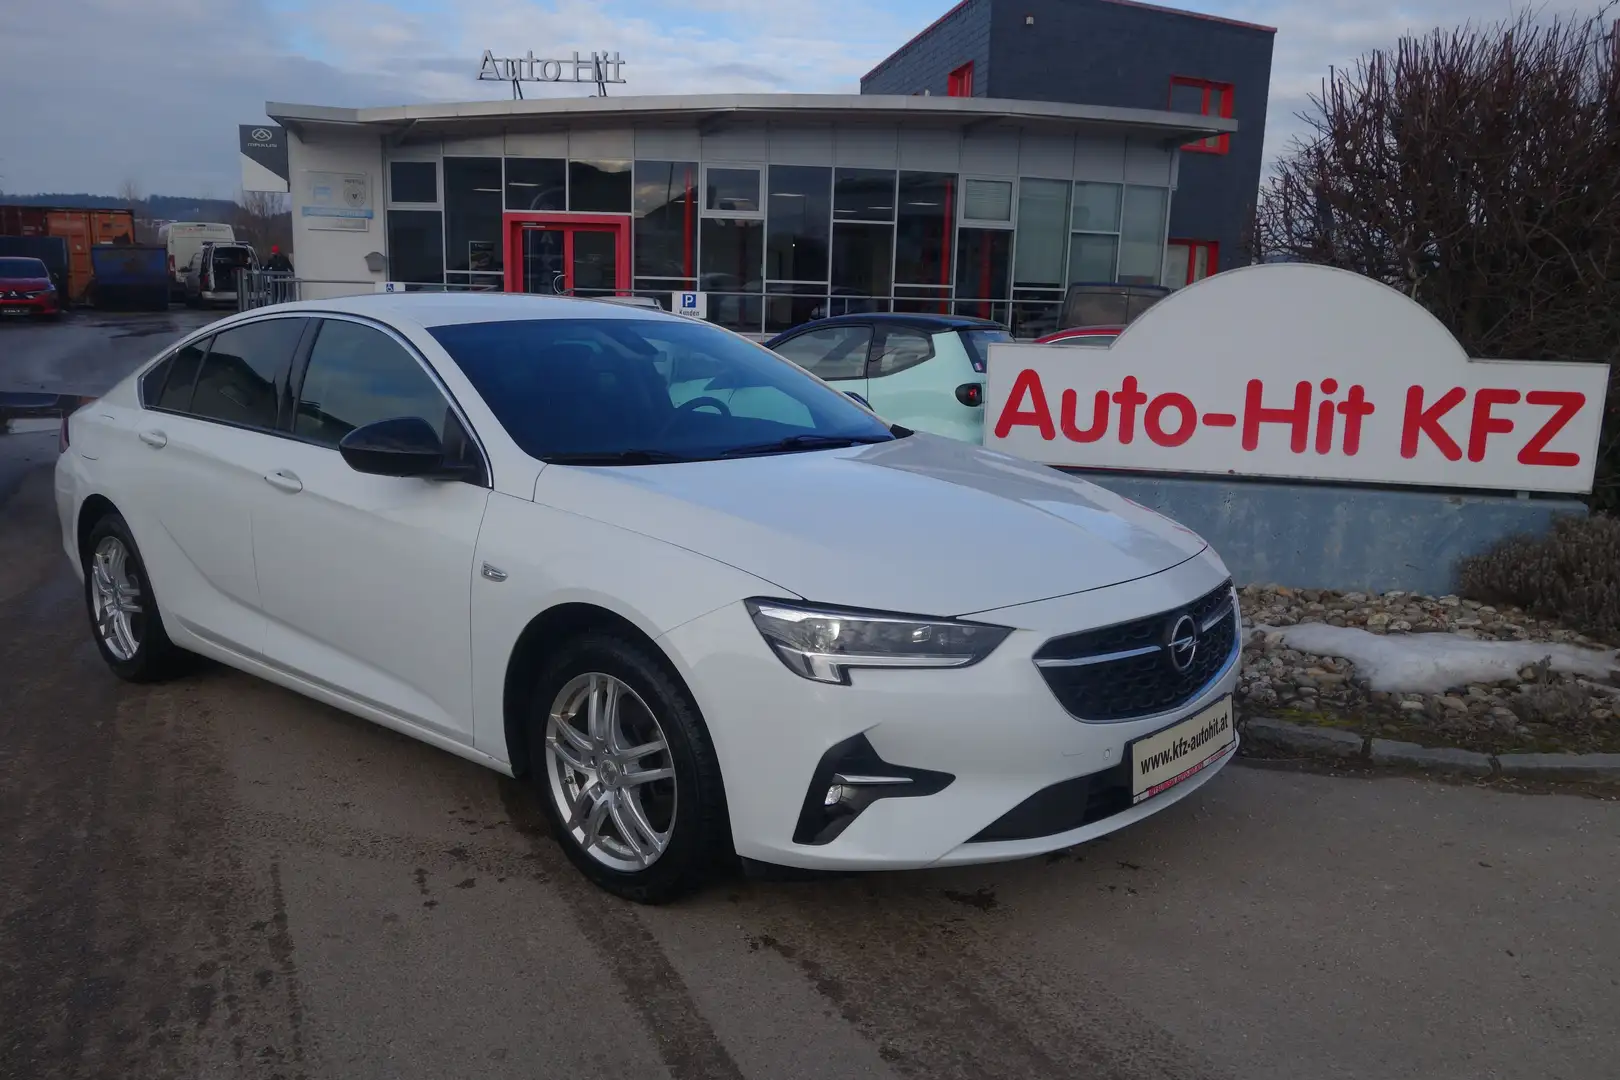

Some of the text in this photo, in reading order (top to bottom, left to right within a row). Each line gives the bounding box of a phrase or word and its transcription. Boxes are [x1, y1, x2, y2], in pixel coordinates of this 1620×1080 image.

[477, 49, 626, 83] Auto Hit
[679, 309, 700, 317] Kunden
[995, 369, 1586, 466] Auto-Hit KFZ
[1140, 712, 1229, 775] www.kfz-autohit.at
